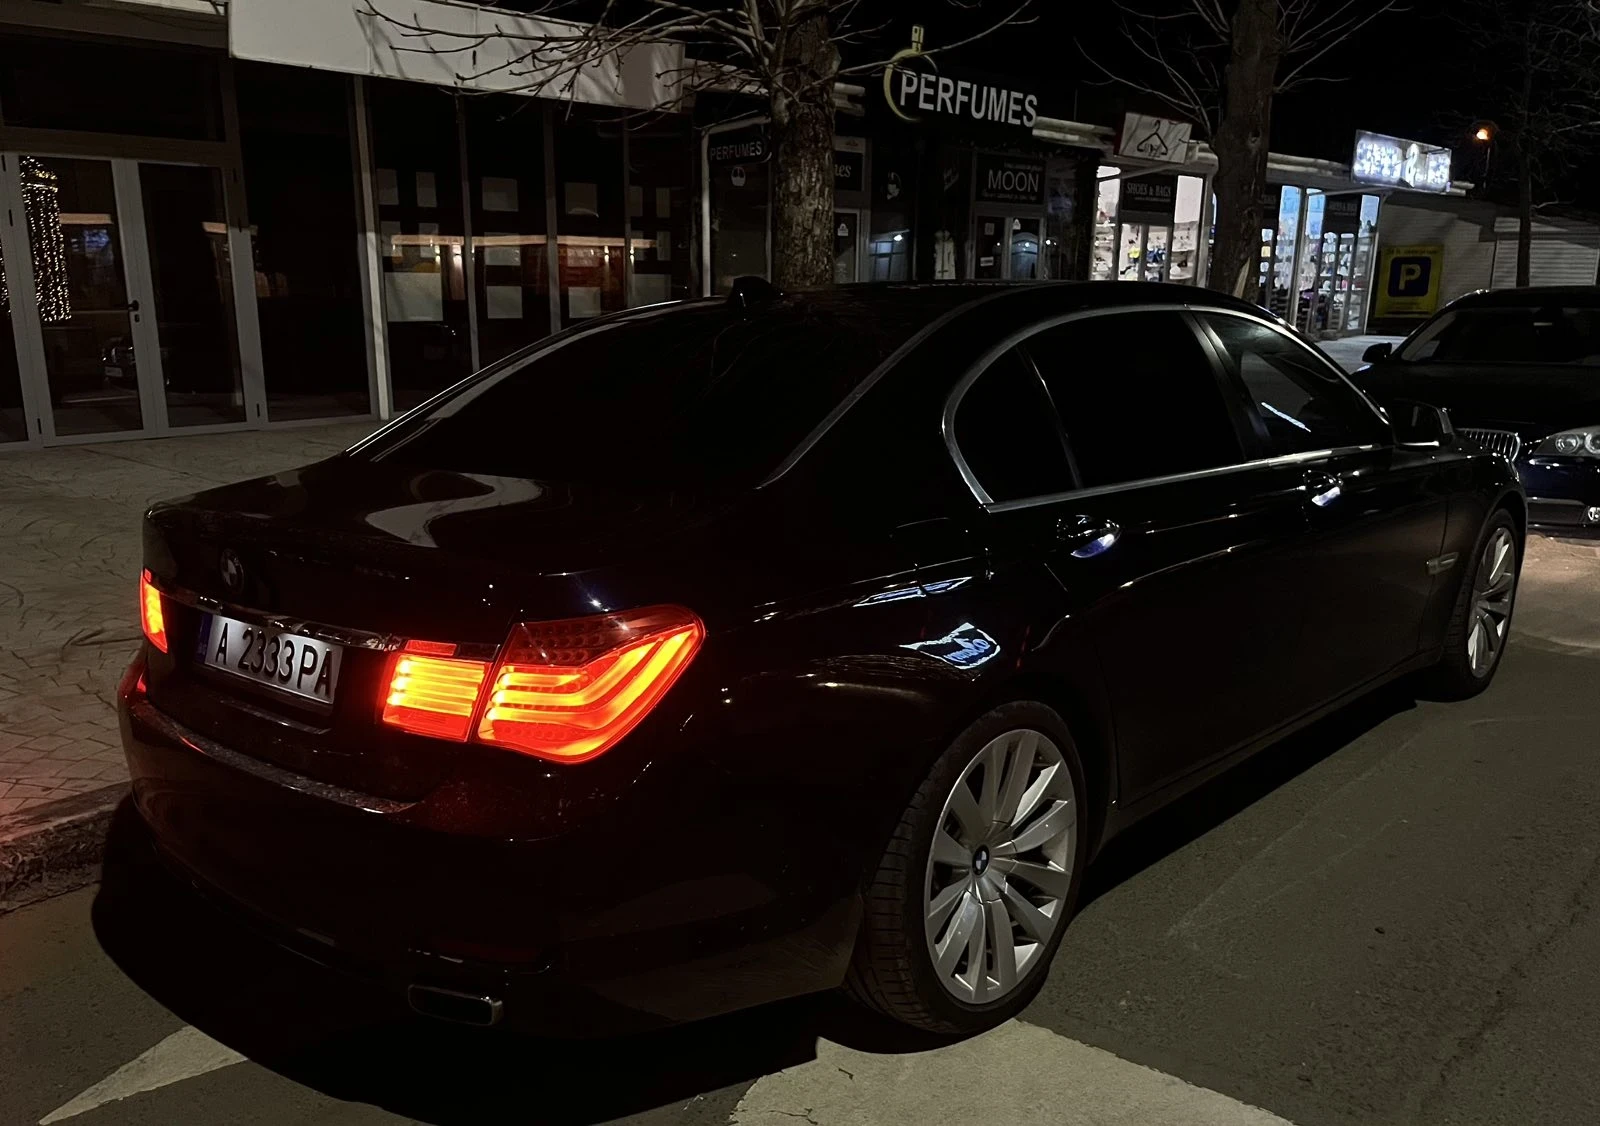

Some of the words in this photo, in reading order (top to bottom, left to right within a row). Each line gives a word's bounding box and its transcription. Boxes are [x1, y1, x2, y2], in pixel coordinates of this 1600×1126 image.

[900, 71, 1038, 127] PERFUMES
[710, 142, 761, 160] PERFUMES
[988, 169, 1039, 193] MOON
[1399, 265, 1422, 291] P
[215, 623, 229, 665] A
